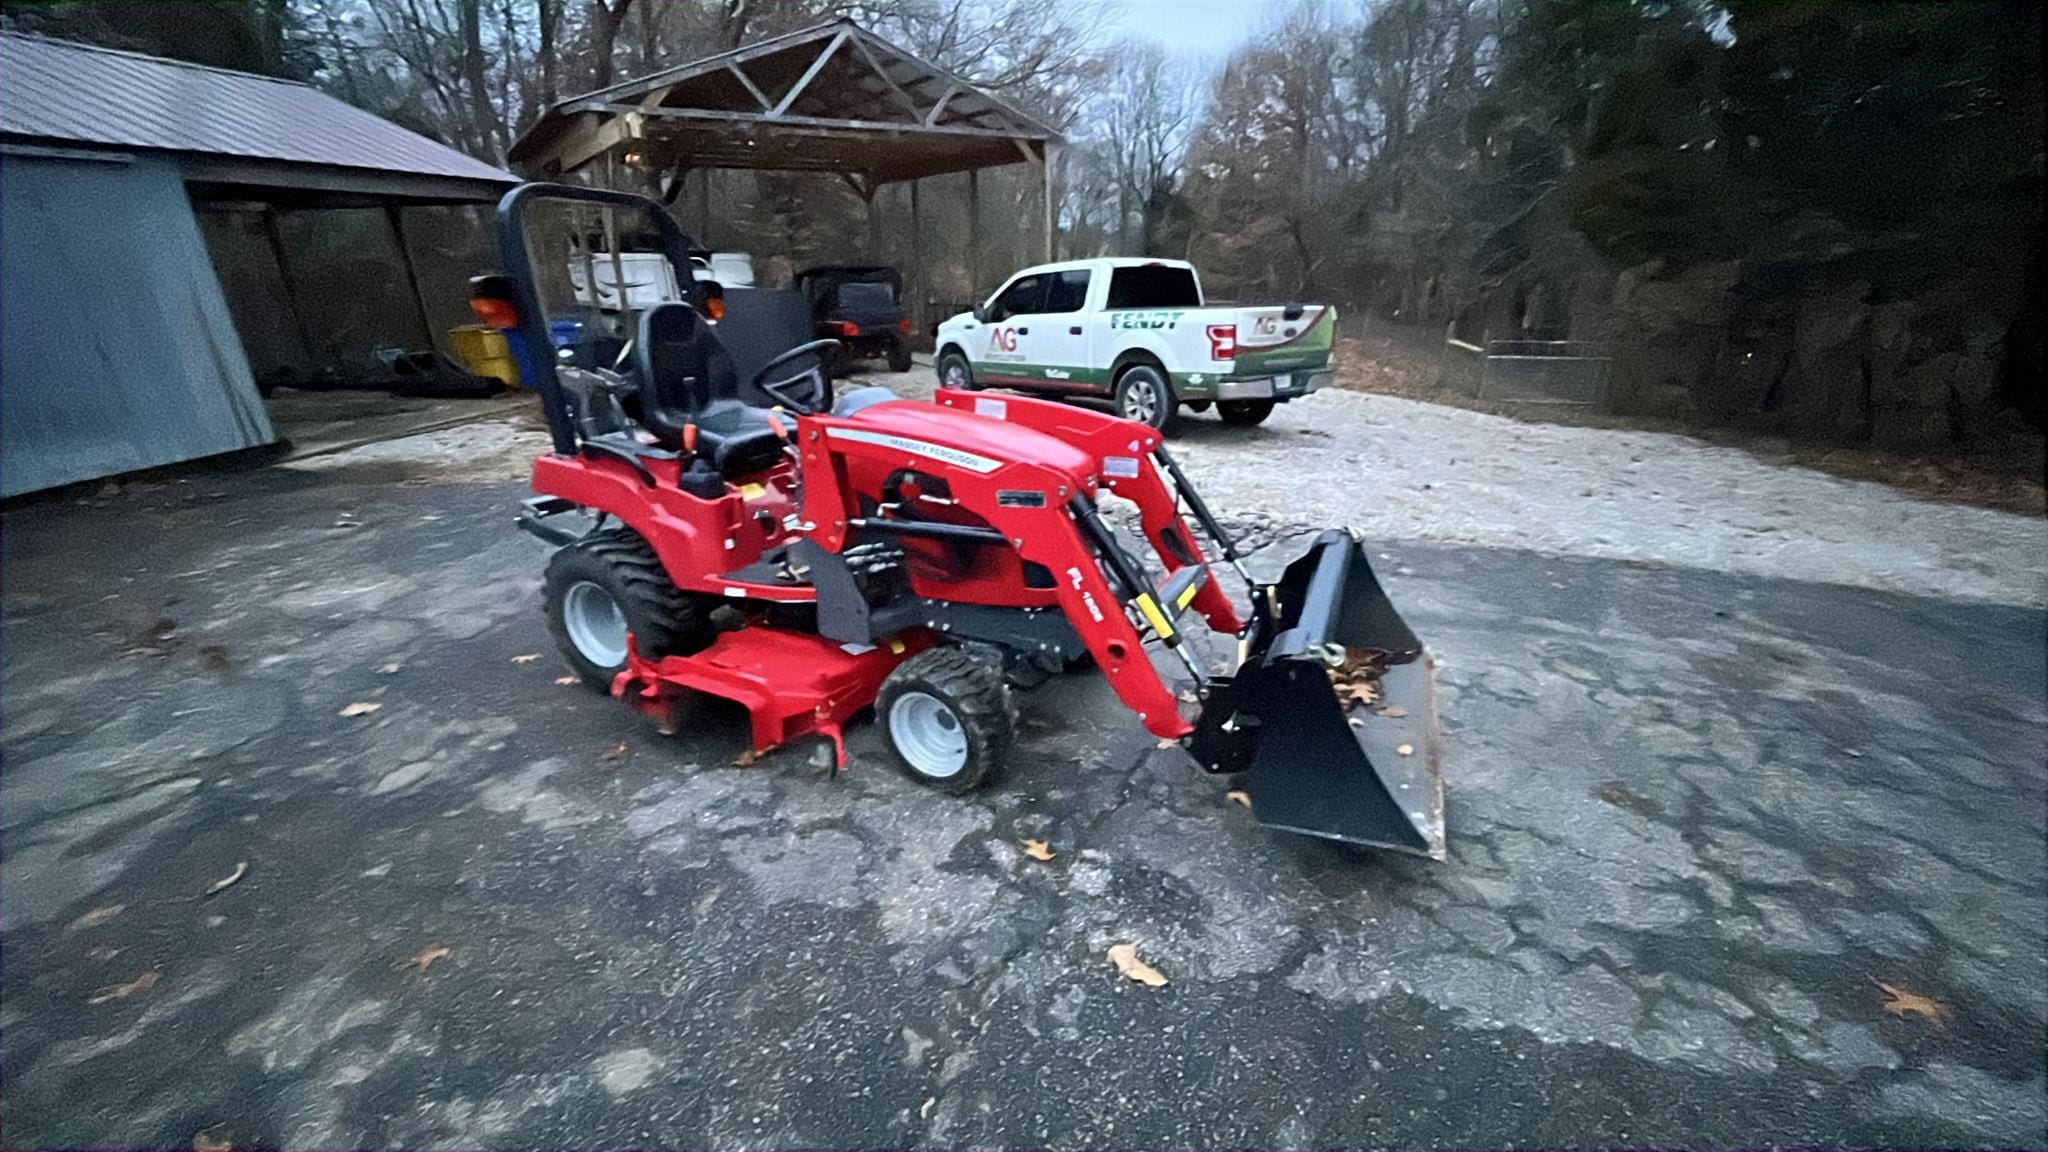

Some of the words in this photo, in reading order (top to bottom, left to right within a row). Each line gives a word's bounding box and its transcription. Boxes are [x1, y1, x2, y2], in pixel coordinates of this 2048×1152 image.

[1111, 311, 1185, 329] FENDT
[990, 327, 1017, 352] AG
[1066, 566, 1083, 590] FL
